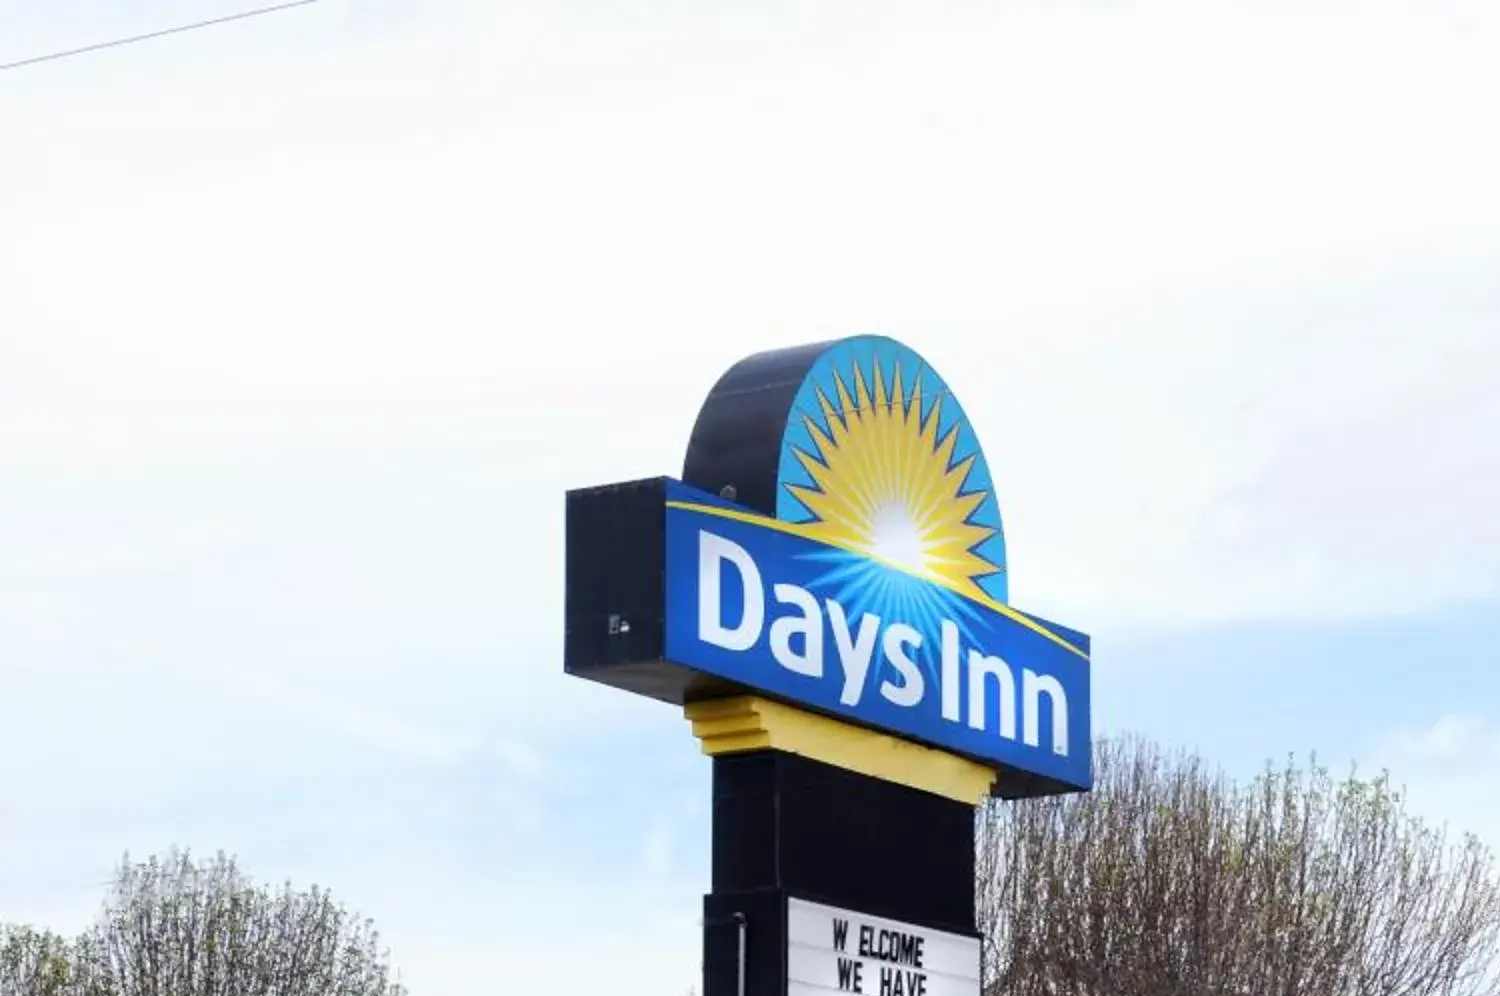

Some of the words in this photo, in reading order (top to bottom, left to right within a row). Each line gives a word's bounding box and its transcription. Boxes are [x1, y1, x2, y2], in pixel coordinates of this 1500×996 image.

[698, 529, 925, 707] Days
[941, 620, 1070, 757] Inn
[837, 957, 863, 995] WE
